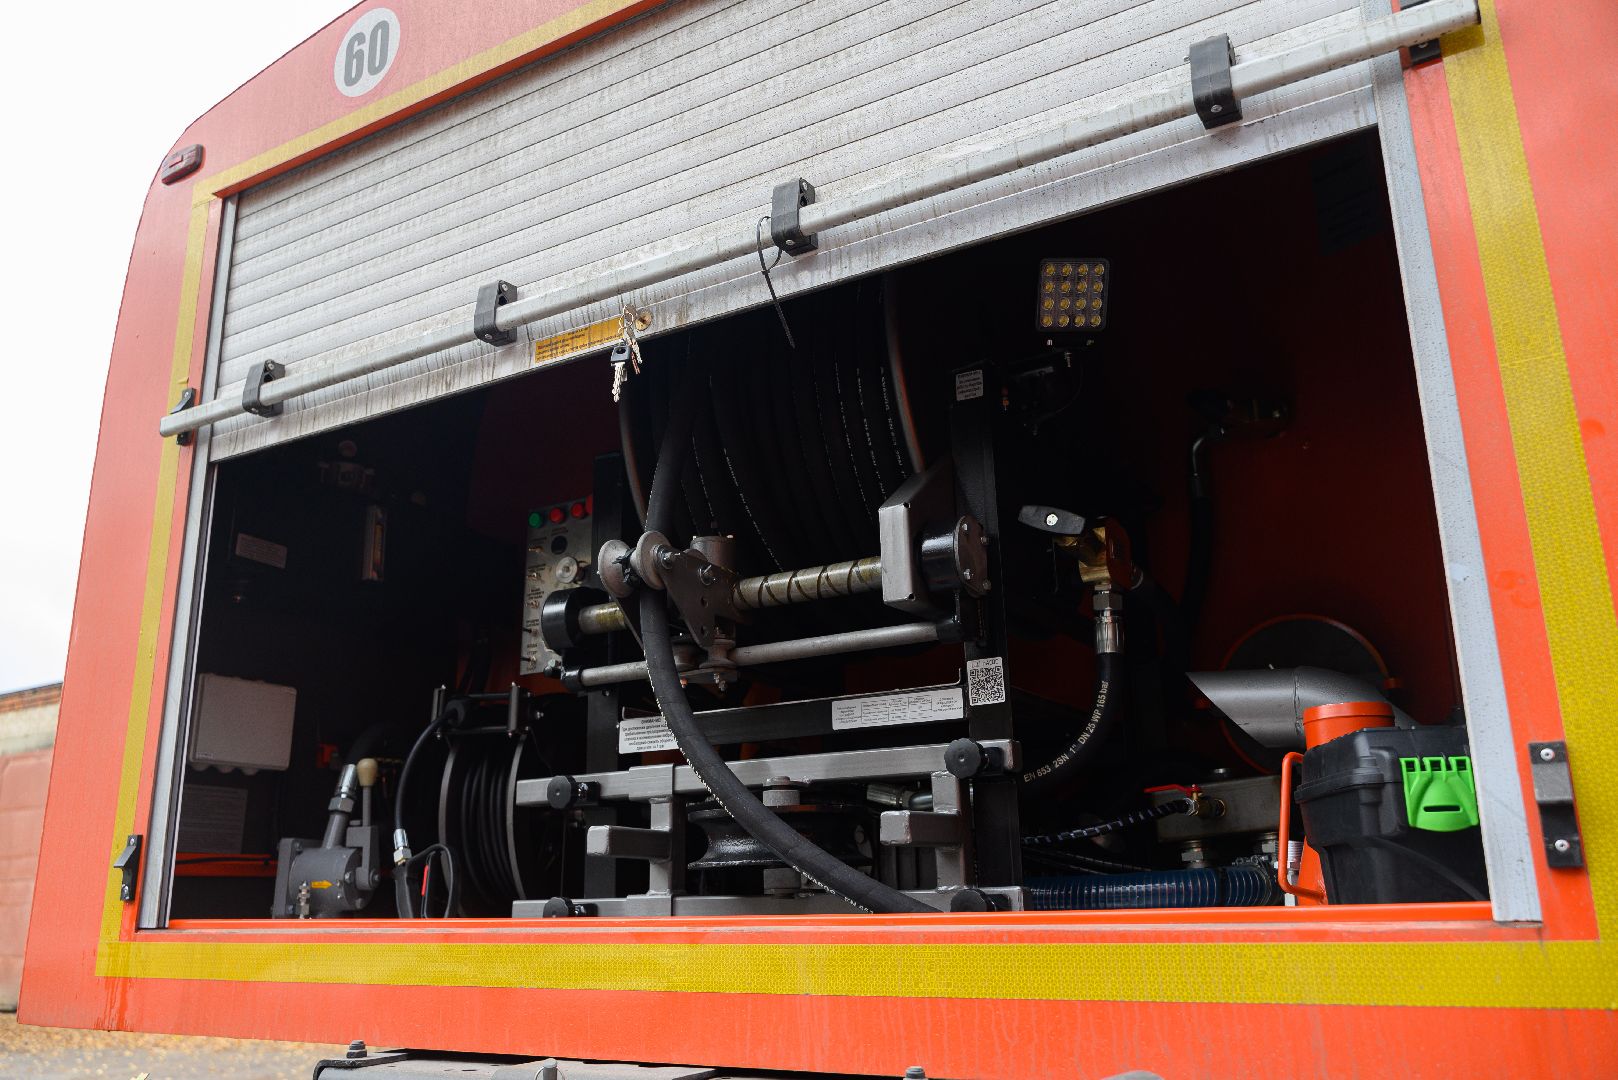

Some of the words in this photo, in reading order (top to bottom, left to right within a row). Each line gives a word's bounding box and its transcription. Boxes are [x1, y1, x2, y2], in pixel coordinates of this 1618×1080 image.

[343, 20, 390, 87] 60
[1099, 680, 1109, 694] bar
[1096, 694, 1106, 708] 165
[1091, 709, 1102, 723] WP
[1085, 722, 1096, 733] 25
[1077, 732, 1091, 744] DN
[1052, 753, 1070, 768] 2SN
[1023, 772, 1036, 782] EN
